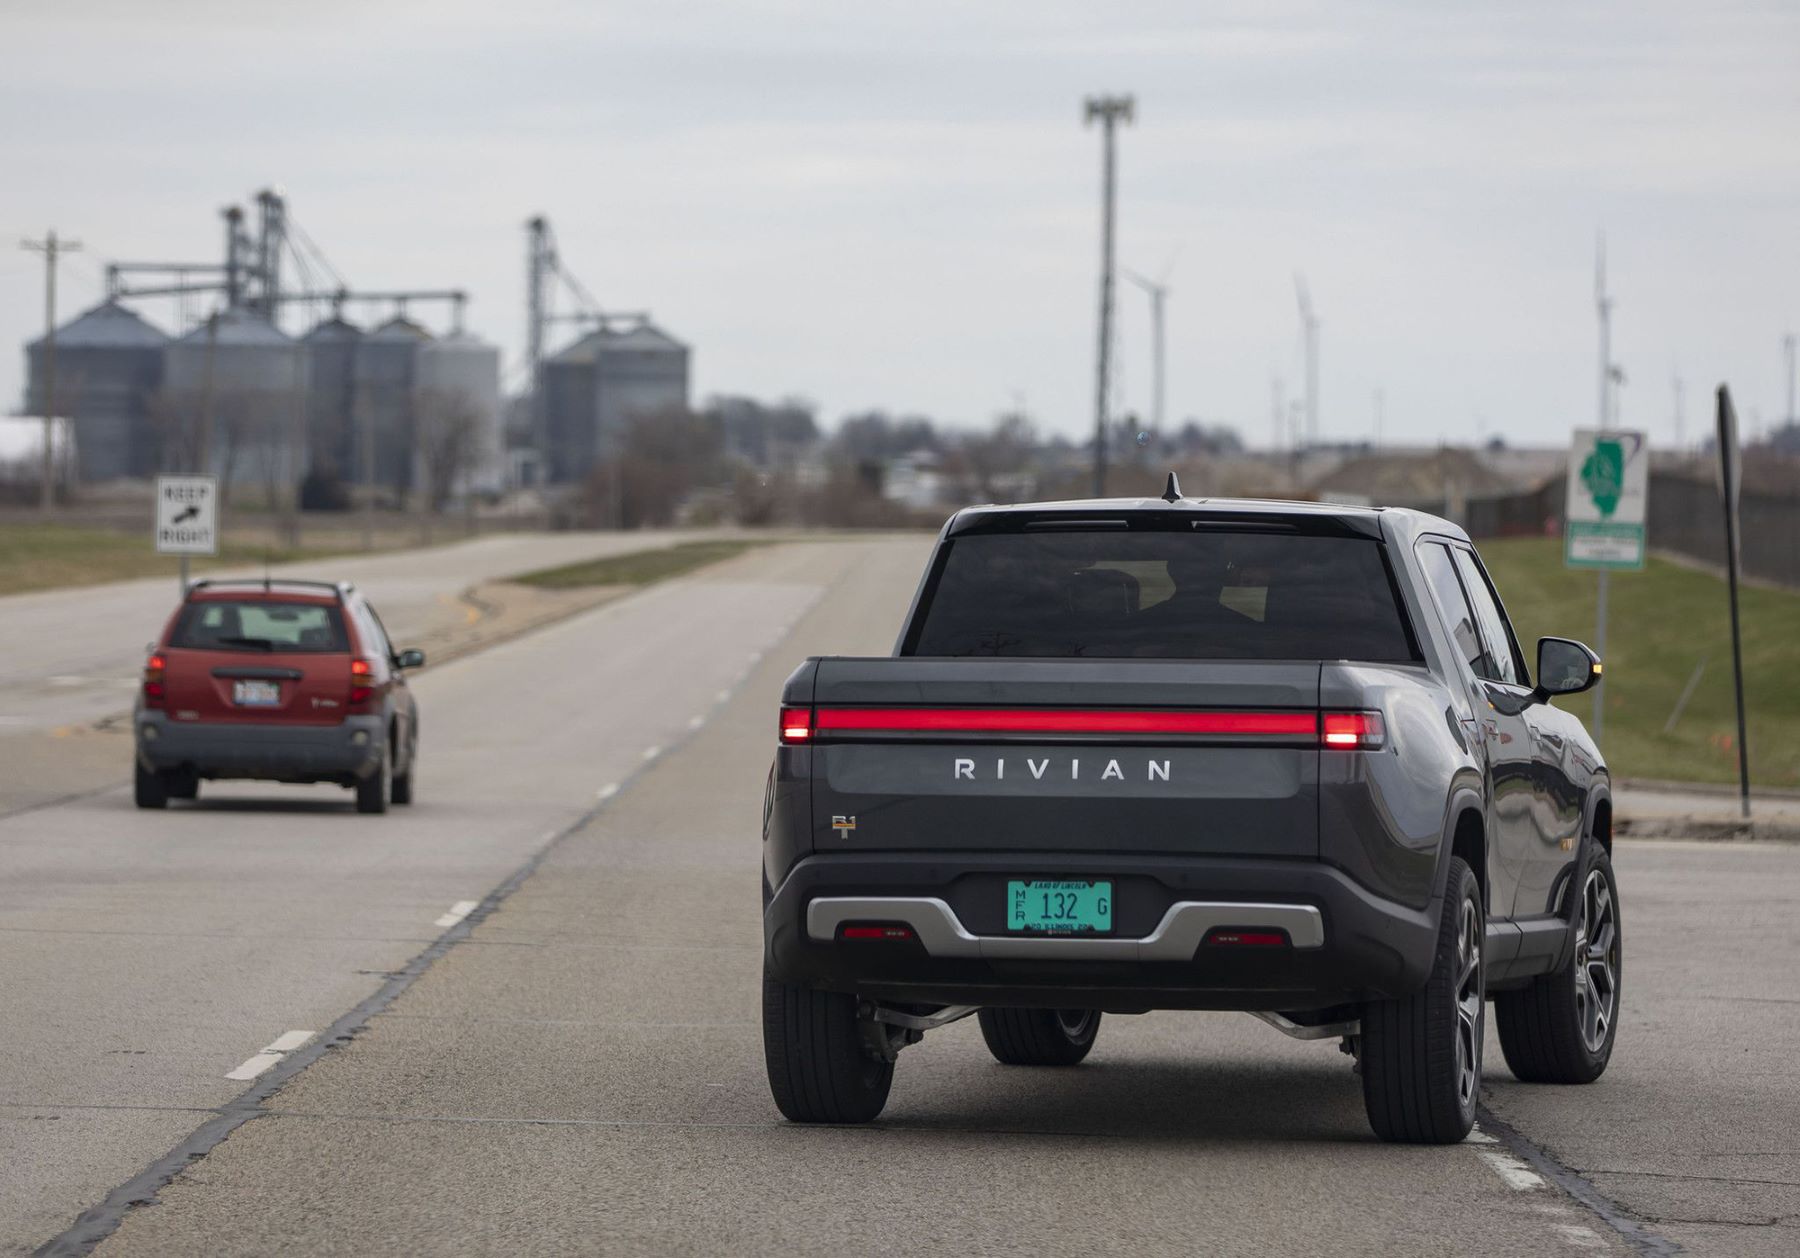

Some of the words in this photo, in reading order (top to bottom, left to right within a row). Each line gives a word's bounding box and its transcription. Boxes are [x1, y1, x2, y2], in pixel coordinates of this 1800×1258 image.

[164, 485, 207, 501] KEEP
[160, 528, 209, 544] RIGHT
[954, 758, 1171, 781] RIVIAN
[1040, 892, 1078, 919] 132
[1097, 897, 1108, 916] G
